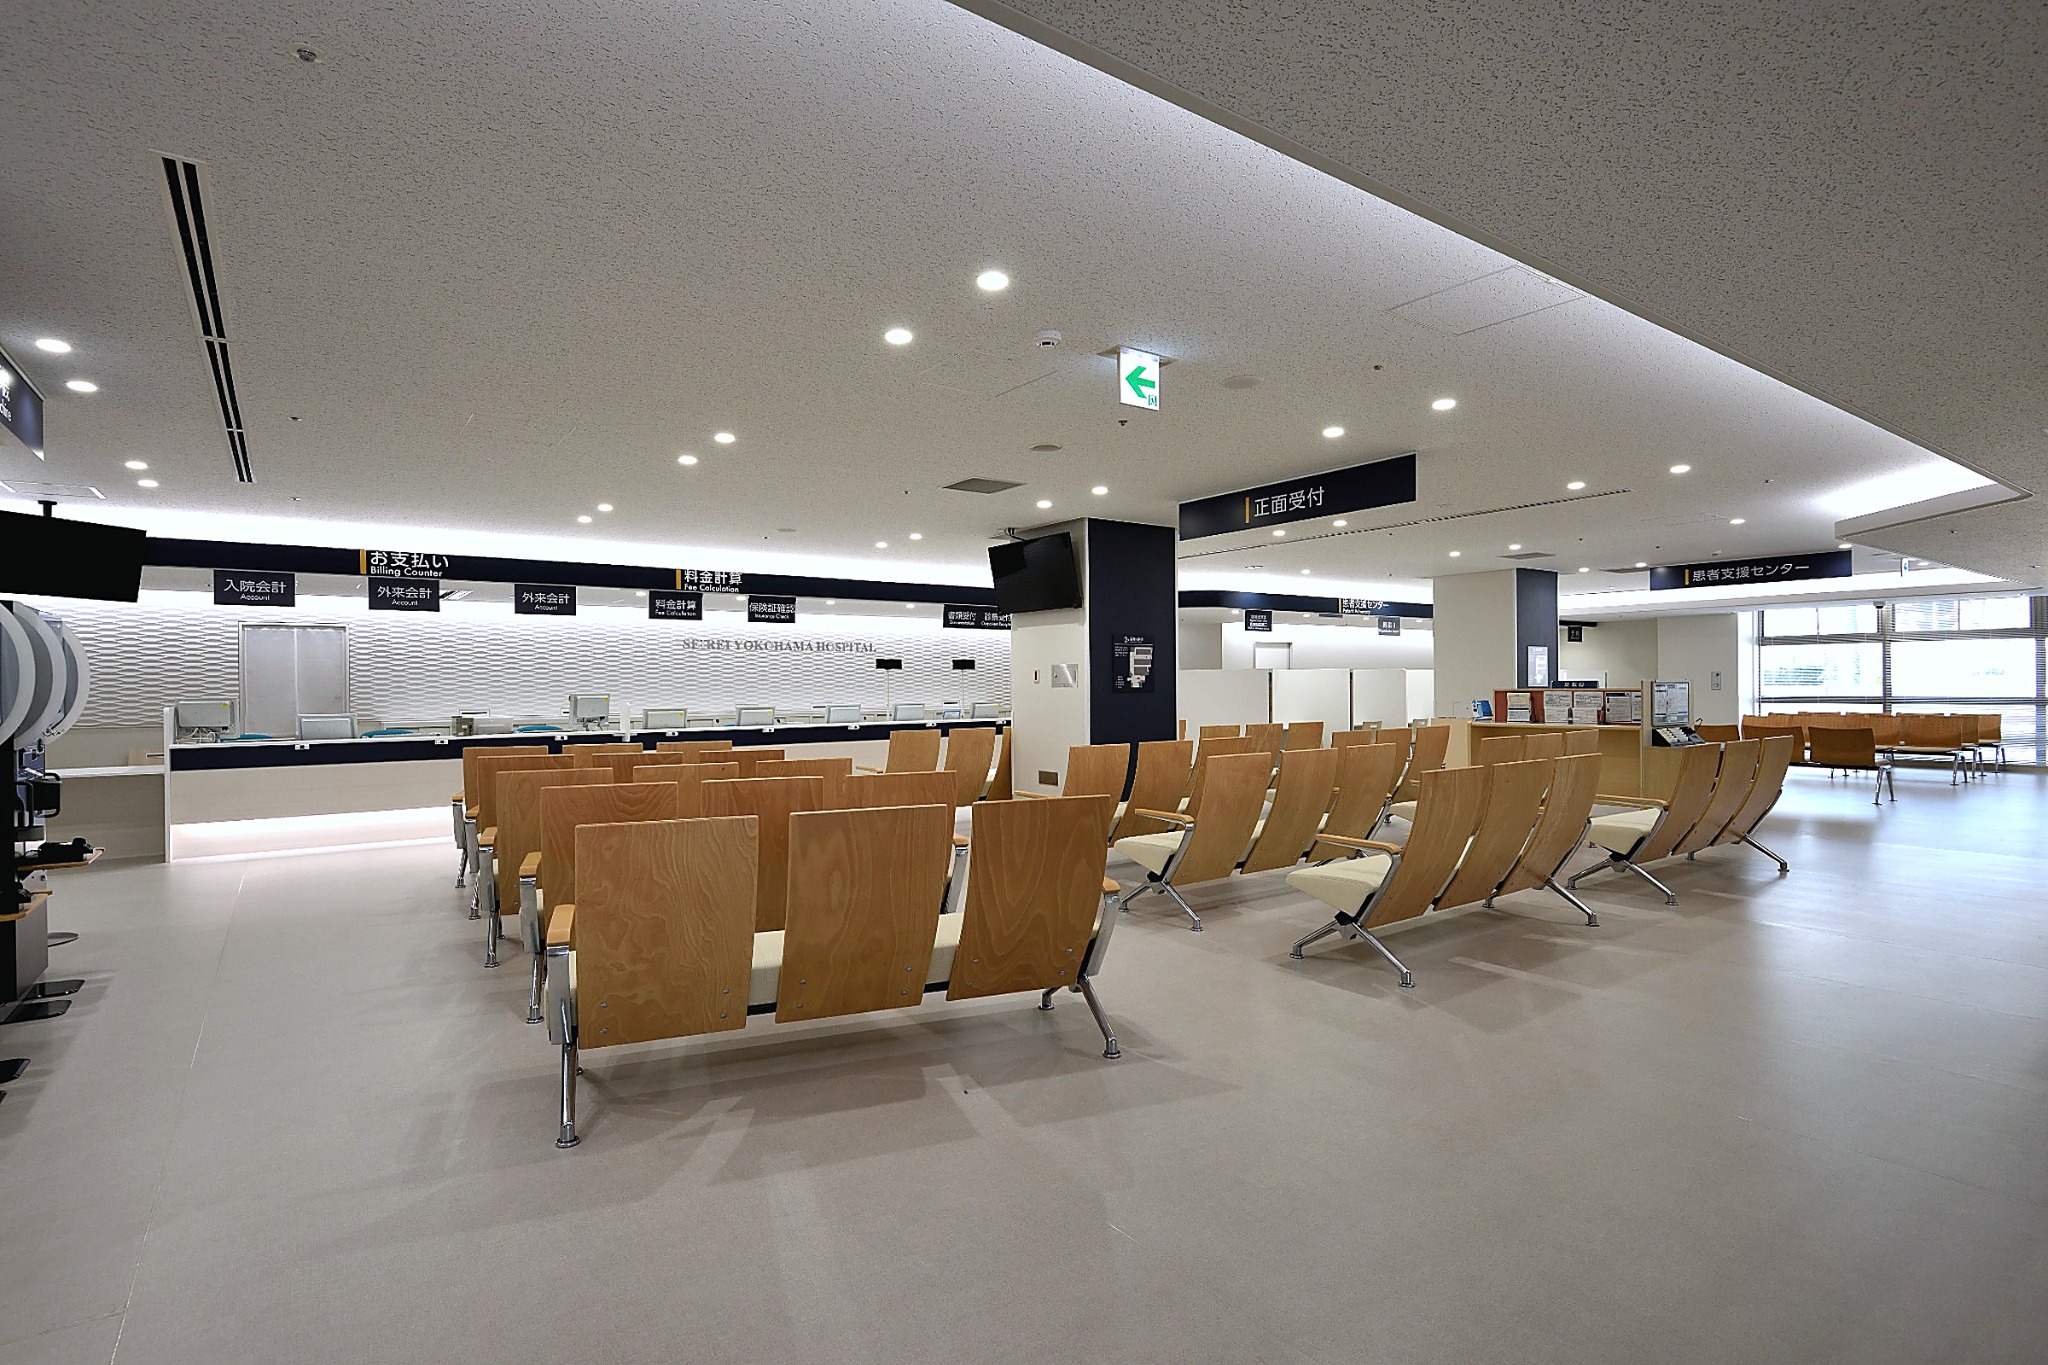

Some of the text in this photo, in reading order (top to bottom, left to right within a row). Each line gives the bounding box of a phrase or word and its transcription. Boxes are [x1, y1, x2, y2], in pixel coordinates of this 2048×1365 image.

[1254, 486, 1325, 517] 正面受付
[370, 551, 449, 569] お支払い
[370, 565, 443, 577] Billing Counter
[684, 569, 743, 585] 料金計算
[1692, 564, 1810, 582] 患者支援センター
[223, 579, 287, 594] 入院会計
[377, 585, 433, 600] 外来会計
[684, 583, 740, 593] Fee Calculation
[240, 593, 270, 602] Account
[391, 598, 418, 607] Account
[522, 592, 570, 604] 外来会計
[655, 599, 697, 610] 料金計算
